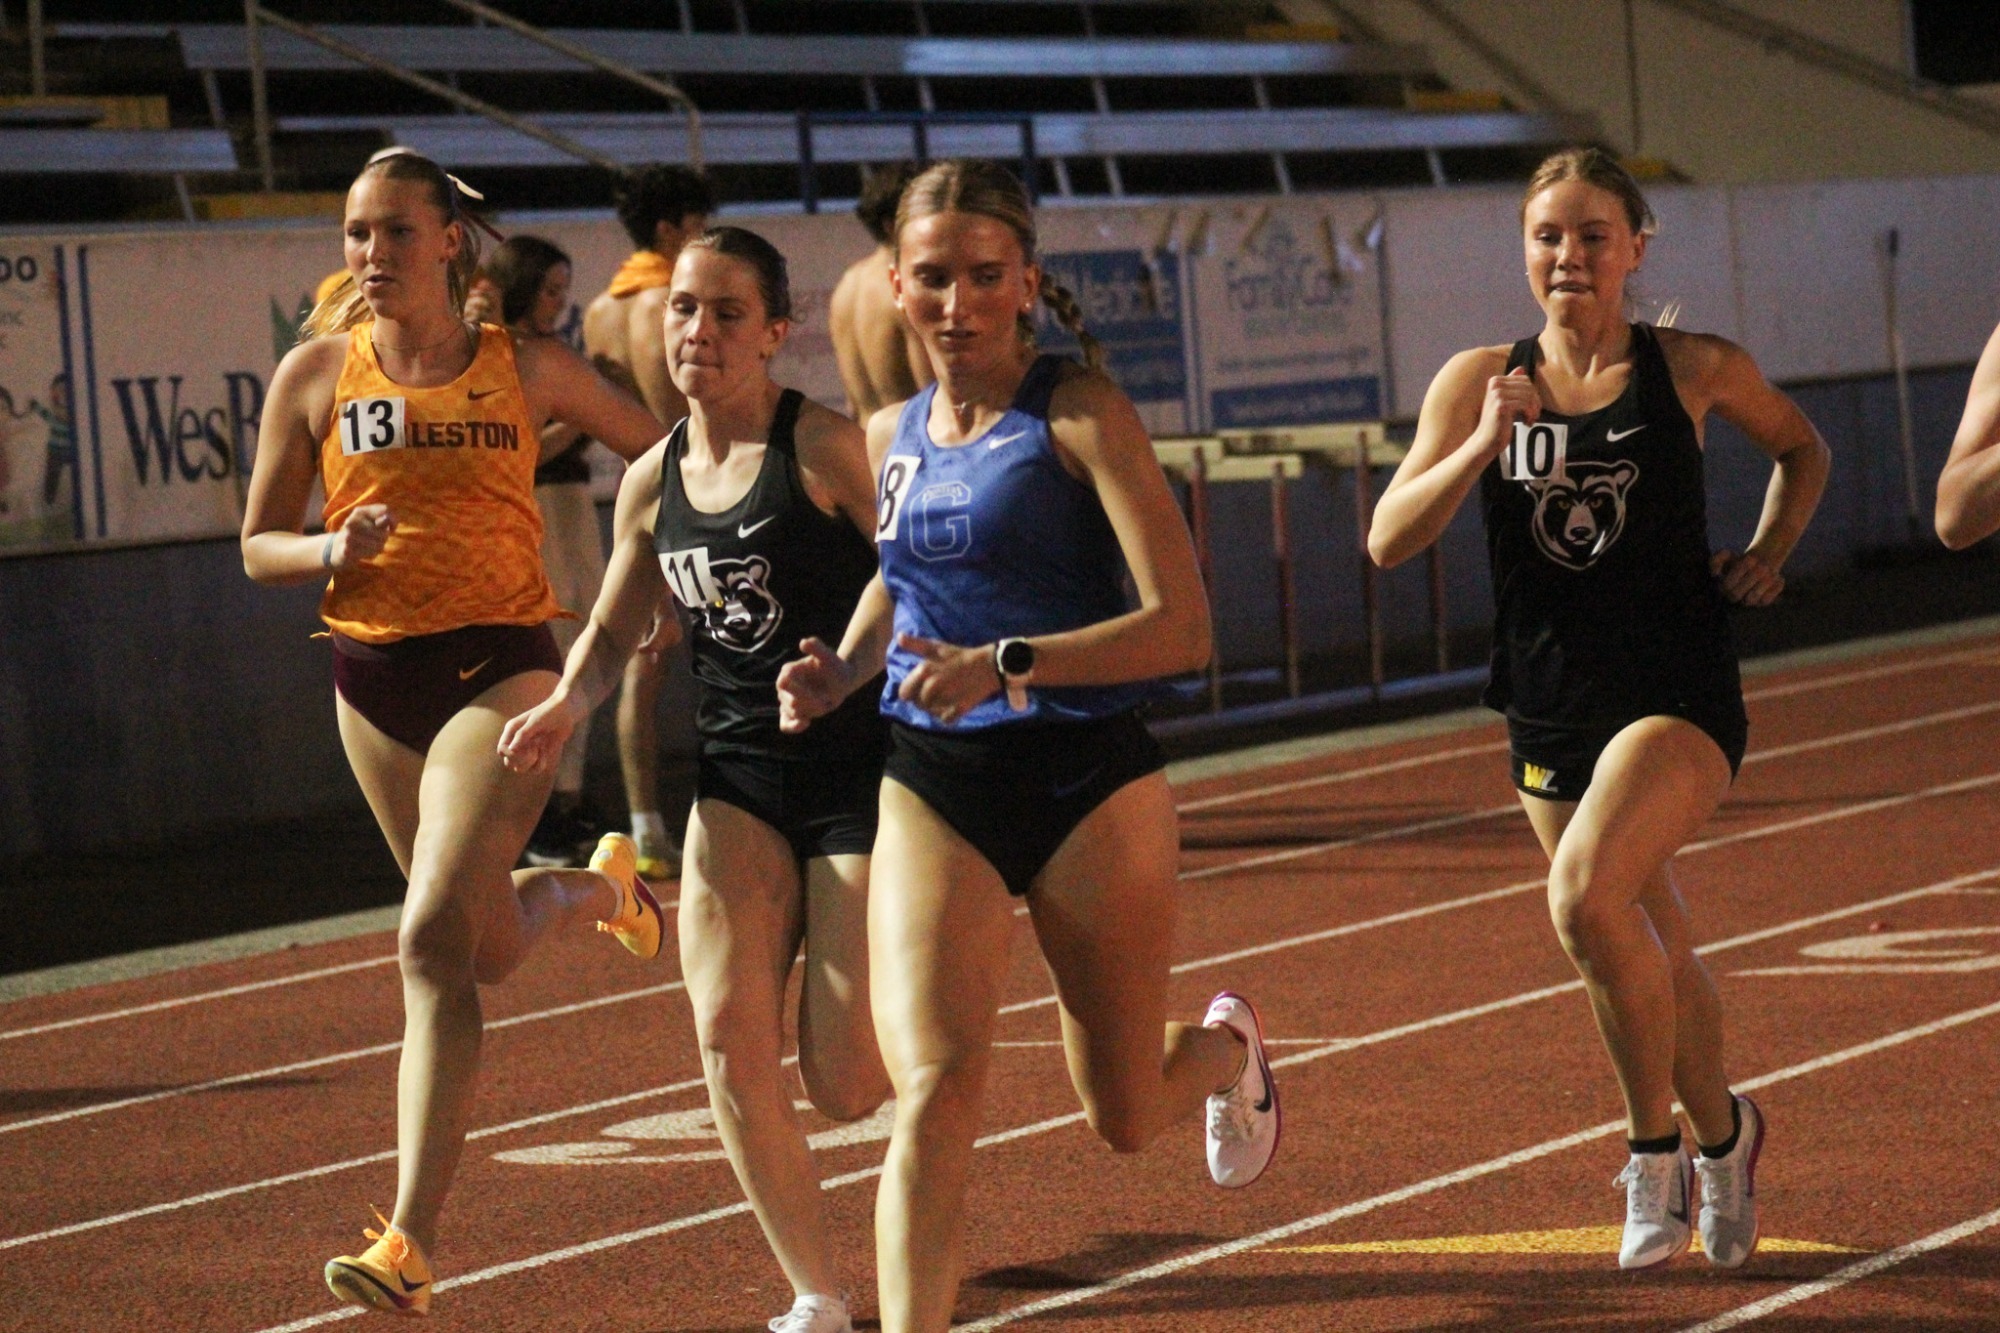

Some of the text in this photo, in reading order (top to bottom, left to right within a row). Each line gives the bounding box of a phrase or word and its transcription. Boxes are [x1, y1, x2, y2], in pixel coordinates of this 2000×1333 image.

[111, 370, 266, 487] WesB
[343, 399, 394, 452] 13
[405, 421, 519, 451] LESTON
[1510, 423, 1556, 477] 10
[879, 461, 907, 533] 8
[908, 480, 972, 563] G
[668, 553, 707, 604] 11
